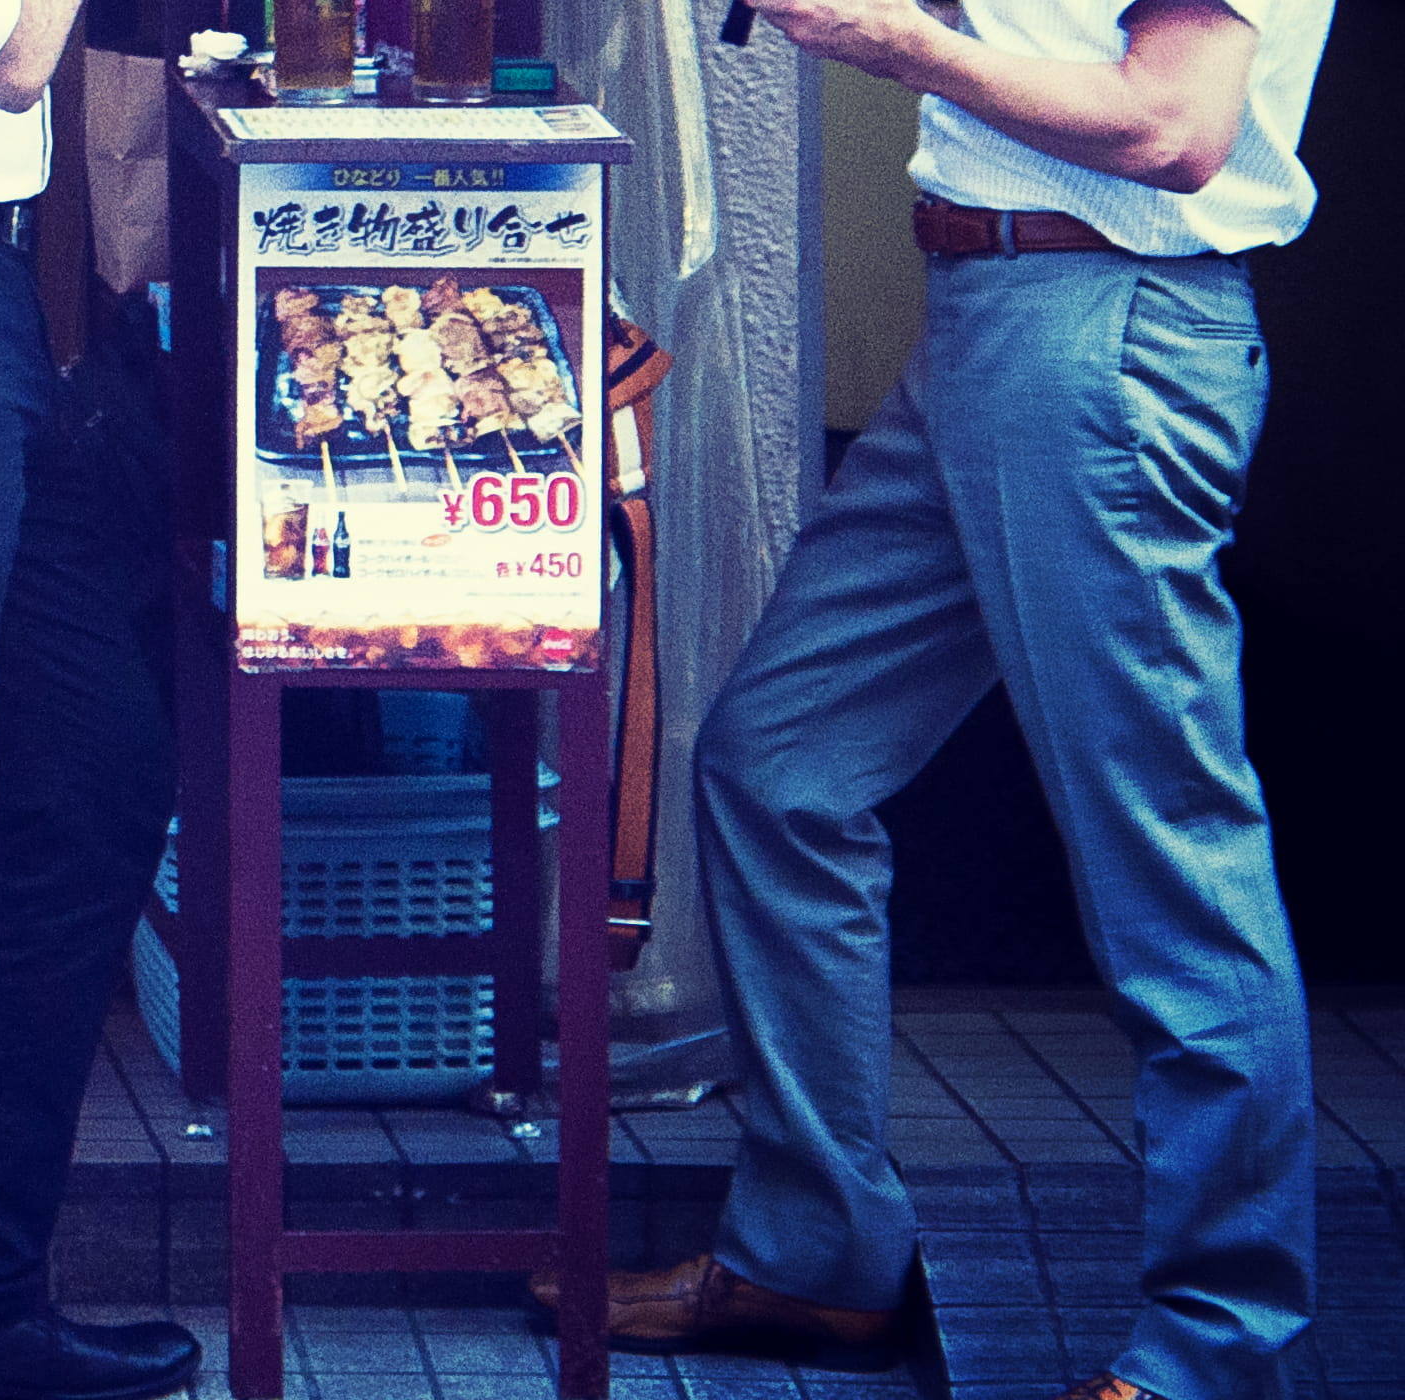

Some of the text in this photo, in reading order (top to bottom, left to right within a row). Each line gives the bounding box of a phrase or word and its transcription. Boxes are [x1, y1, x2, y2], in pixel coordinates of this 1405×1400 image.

[333, 168, 402, 187] ひなどり
[253, 202, 593, 256] 焼き物盛り合せ
[444, 476, 581, 529] ¥650
